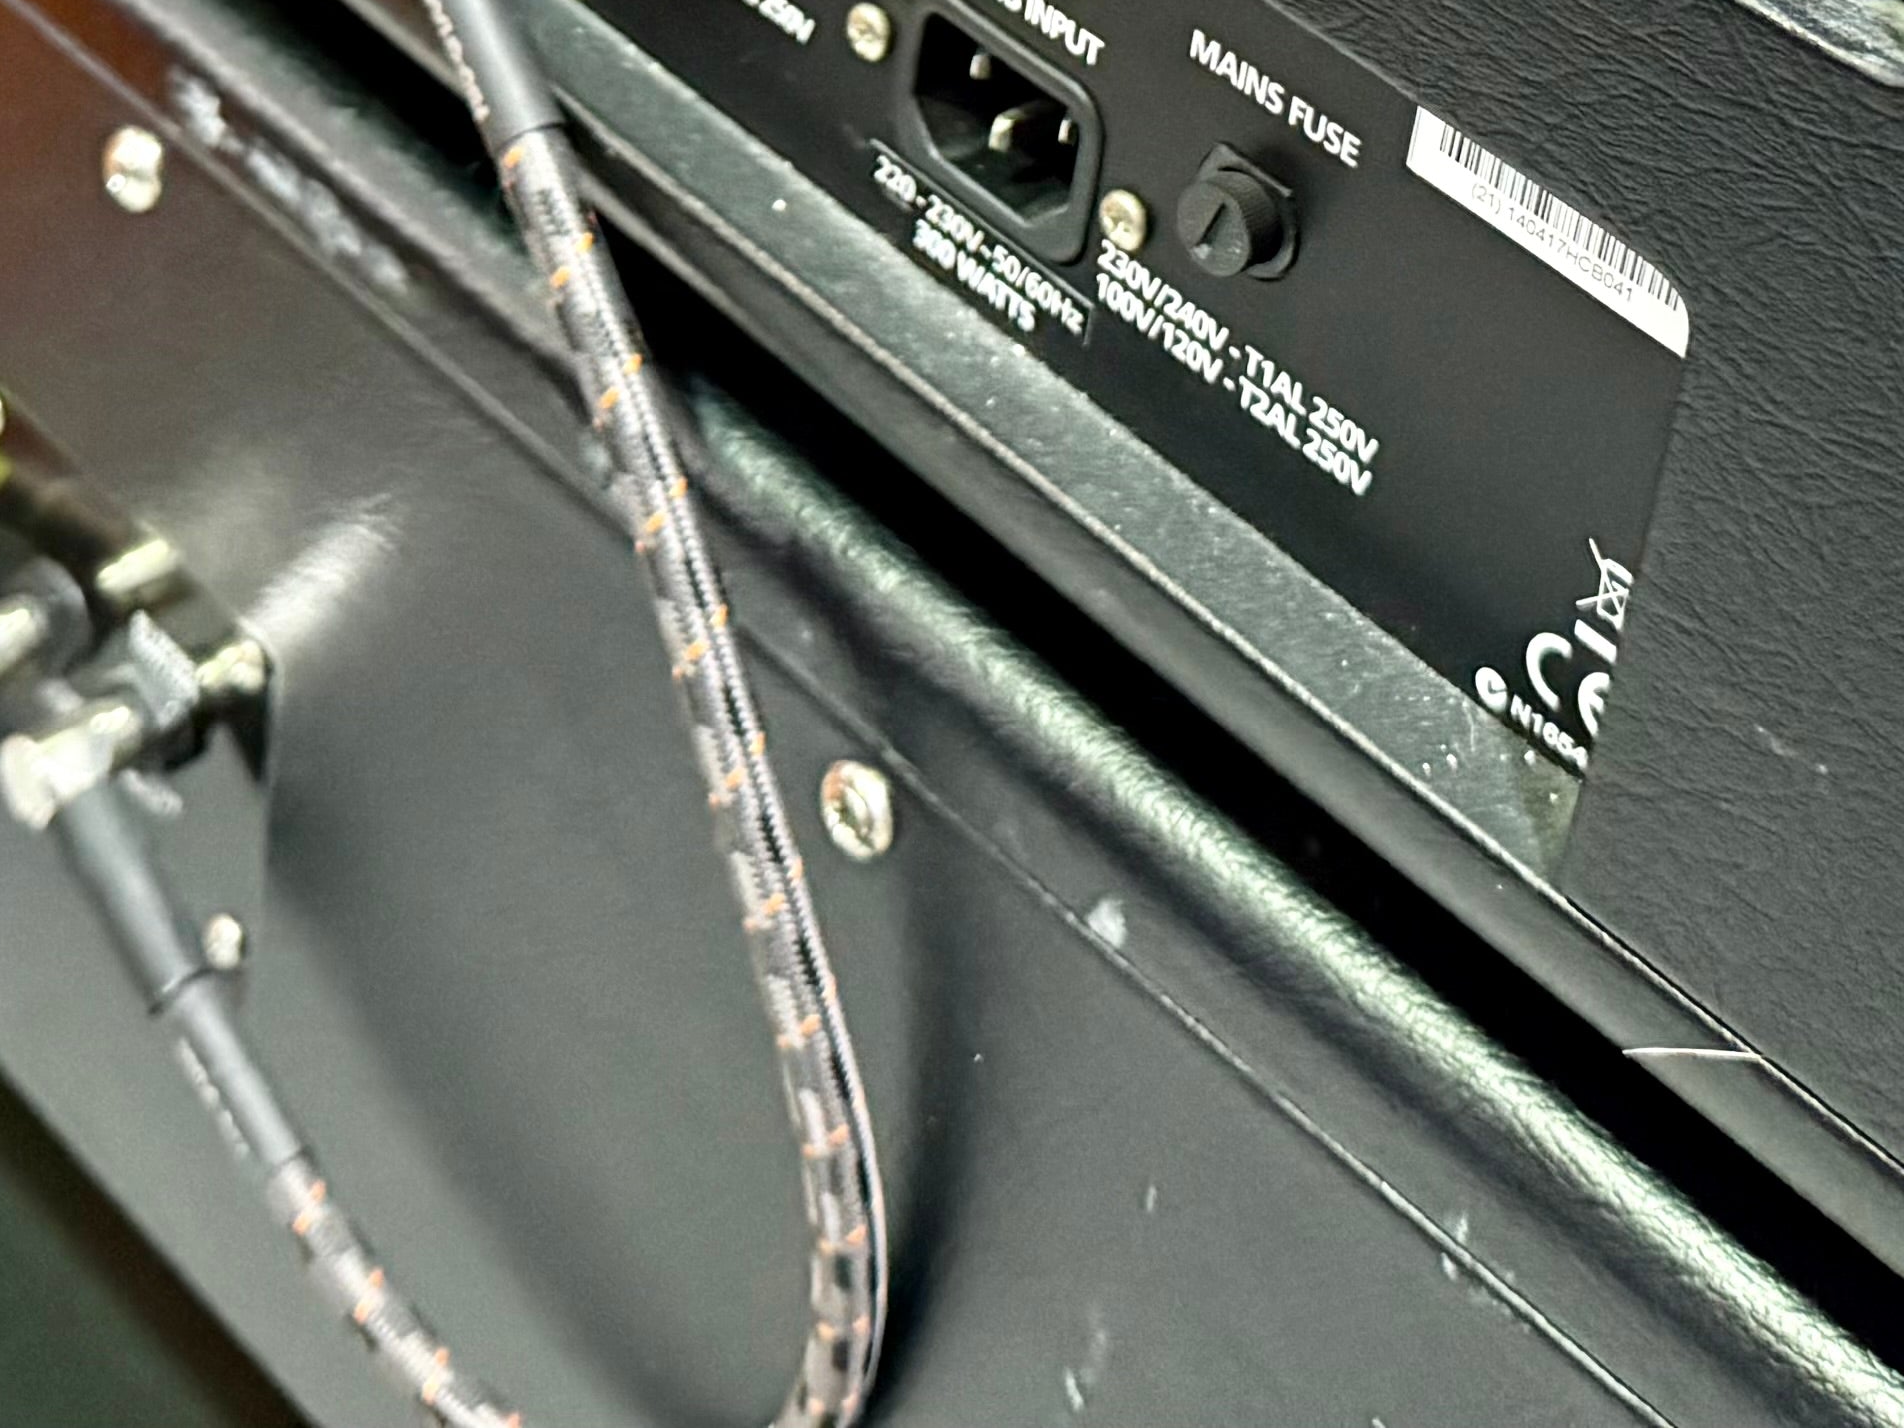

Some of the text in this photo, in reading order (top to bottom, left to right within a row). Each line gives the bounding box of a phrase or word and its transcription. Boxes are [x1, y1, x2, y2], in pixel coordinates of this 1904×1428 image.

[1189, 28, 1363, 169] MAINS FUSE
[1469, 182, 1502, 215] (21)
[957, 250, 1037, 332] WATTS
[1096, 238, 1230, 351] 230V/240V
[1245, 344, 1307, 417] T1AL
[1308, 395, 1380, 465] 250V
[1096, 272, 1223, 384] 100V/120V
[1239, 375, 1301, 451] T2AL
[1302, 427, 1373, 495] 250V
